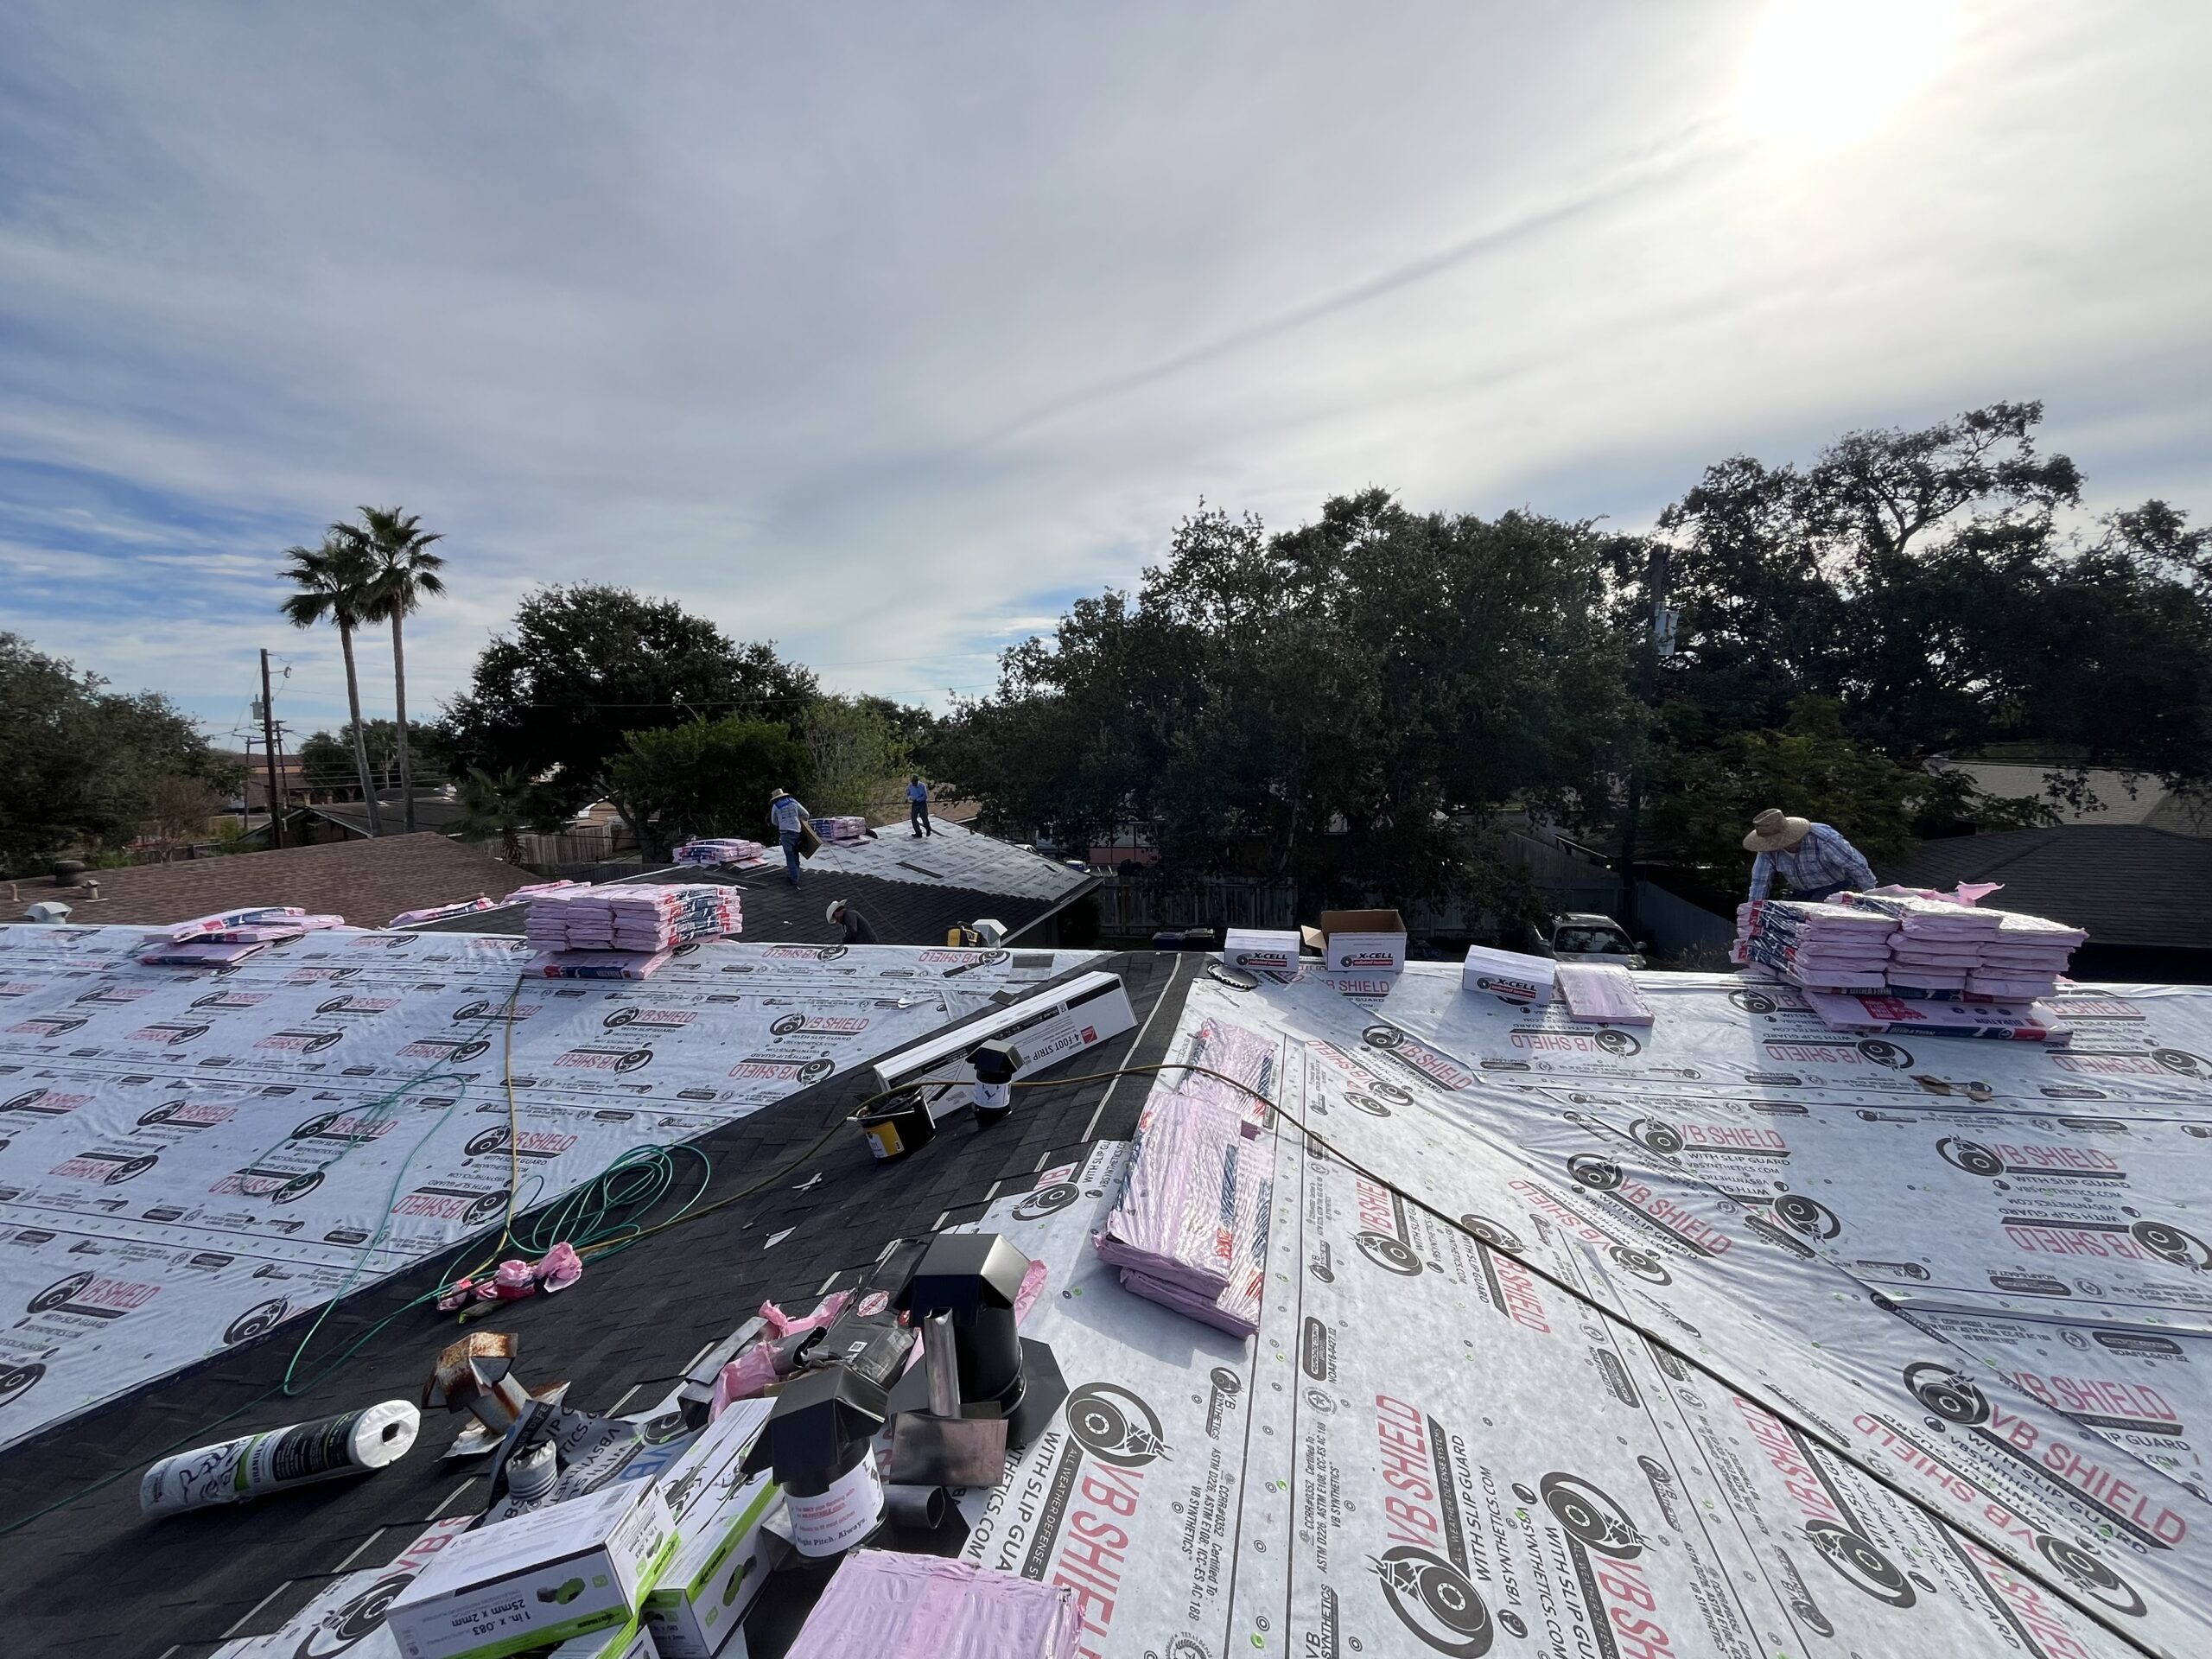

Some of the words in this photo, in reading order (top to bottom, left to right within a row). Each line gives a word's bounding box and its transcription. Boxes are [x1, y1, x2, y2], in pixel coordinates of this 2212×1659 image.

[761, 950, 800, 958] SHIELD
[918, 951, 960, 963] SHIELD
[1338, 981, 1389, 993] SHIELD
[655, 1009, 698, 1022] SHIELD
[2067, 1001, 2141, 1015] SHIELD
[823, 1018, 870, 1030] SHIELD
[1033, 1044, 1054, 1061] STRIP
[1512, 1035, 1572, 1051] SHIELD
[1765, 1046, 1837, 1063] SHIELD
[553, 1054, 601, 1068] SHIELD
[728, 1065, 778, 1078] SHIELD
[1416, 1052, 1472, 1090] SHIELD
[2051, 1056, 2136, 1073] SHIELD
[526, 1133, 578, 1152] SHIELD
[1707, 1127, 1786, 1148] SHIELD
[1083, 1165, 1098, 1183] WITH
[1093, 1151, 1104, 1166] SLIP
[1982, 1143, 2028, 1164] VB
[2023, 1146, 2119, 1169] SHIELD
[1509, 1180, 1581, 1227] SHIELD
[1736, 1186, 1770, 1195] WITH
[391, 1194, 450, 1217] SHIELD
[1620, 1175, 1652, 1205] VB
[1648, 1198, 1732, 1255] SHIELD
[1998, 1208, 2048, 1217] GUARD
[1359, 1212, 1393, 1235] VB
[1599, 1194, 1630, 1215] WITH
[1630, 1214, 1655, 1236] SLIP
[1655, 1231, 1698, 1260] GUARD
[1410, 1232, 1425, 1252] WITH
[1461, 1235, 1474, 1255] WITH
[1578, 1228, 1612, 1252] VB
[2005, 1227, 2109, 1257] SHIELD
[2101, 1234, 2158, 1260] VB
[1470, 1254, 1480, 1273] SLIP
[97, 1281, 162, 1308] SHIELD
[1472, 1272, 1489, 1304] GUARD
[1497, 1269, 1551, 1333] SHIELD
[2050, 1376, 2177, 1421] SHIELD
[1033, 1431, 1061, 1472] WITH
[1318, 1434, 1326, 1446] AC
[1376, 1395, 1433, 1501] SHIELD
[1433, 1427, 1446, 1460] SYSTEMS
[2125, 1433, 2191, 1452] GUARD
[1067, 1448, 1079, 1463] ALL
[1209, 1447, 1222, 1475] ASTM
[1306, 1442, 1315, 1475] Certified
[1318, 1445, 1326, 1471] ICC-ES
[1451, 1434, 1473, 1493] GUARD
[1853, 1415, 1978, 1502] SHIELD
[1051, 1464, 1071, 1513] WEATHER
[1082, 1461, 1145, 1517] VB
[1331, 1466, 1340, 1510] SYNTHETICS
[1440, 1457, 1452, 1502] DEFENSE
[1988, 1404, 2040, 1451] VB
[2043, 1440, 2187, 1545] SHIELD
[1019, 1471, 1042, 1523] SLIP
[1190, 1485, 1202, 1501] VB
[1203, 1494, 1215, 1519] ASTM
[1305, 1479, 1315, 1529] CCRR#0352
[1784, 1479, 1841, 1522] VB
[1837, 1478, 1864, 1509] SLIP
[1967, 1433, 2018, 1471] WITH
[2020, 1468, 2066, 1499] SLIP
[2069, 1499, 2149, 1555] GUARD
[1213, 1485, 1230, 1537] CCRR#0352
[1317, 1496, 1327, 1520] ASTM
[1332, 1513, 1341, 1529] VB
[1385, 1496, 1439, 1548] VB
[1447, 1498, 1460, 1543] WEATHER
[1462, 1493, 1483, 1539] SLIP
[814, 1536, 836, 1546] Pitch.
[1035, 1513, 1058, 1563] DEFENSE
[1182, 1498, 1199, 1555] SYNTHETICS
[1486, 1465, 1522, 1606] VBSYNTHETICS.COM
[1858, 1511, 1891, 1550] WITH
[1982, 1502, 2038, 1551] VB
[1194, 1547, 1208, 1583] ICC-ES
[1208, 1544, 1222, 1583] Certified
[1316, 1548, 1327, 1573] ASTM
[1452, 1545, 1464, 1565] ALL
[1467, 1534, 1491, 1582] WITH
[1573, 1542, 1585, 1560] ALL
[1543, 1527, 1569, 1576] WITH
[1562, 1581, 1584, 1622] SLIP
[1578, 1561, 1600, 1616] WEATHER
[1593, 1554, 1656, 1615] VB
[1682, 1540, 1702, 1569] ASTM
[1704, 1590, 1723, 1620] ASTM
[1688, 1581, 1701, 1595] VB
[1192, 1582, 1204, 1599] AC
[1934, 1539, 1969, 1581] SLIP
[1967, 1583, 2021, 1649] GUARD
[451, 1613, 480, 1628] 2mm
[491, 1599, 526, 1616] 25mm
[1188, 1600, 1201, 1621] 188
[1694, 1594, 1728, 1654] SYNTHETICS
